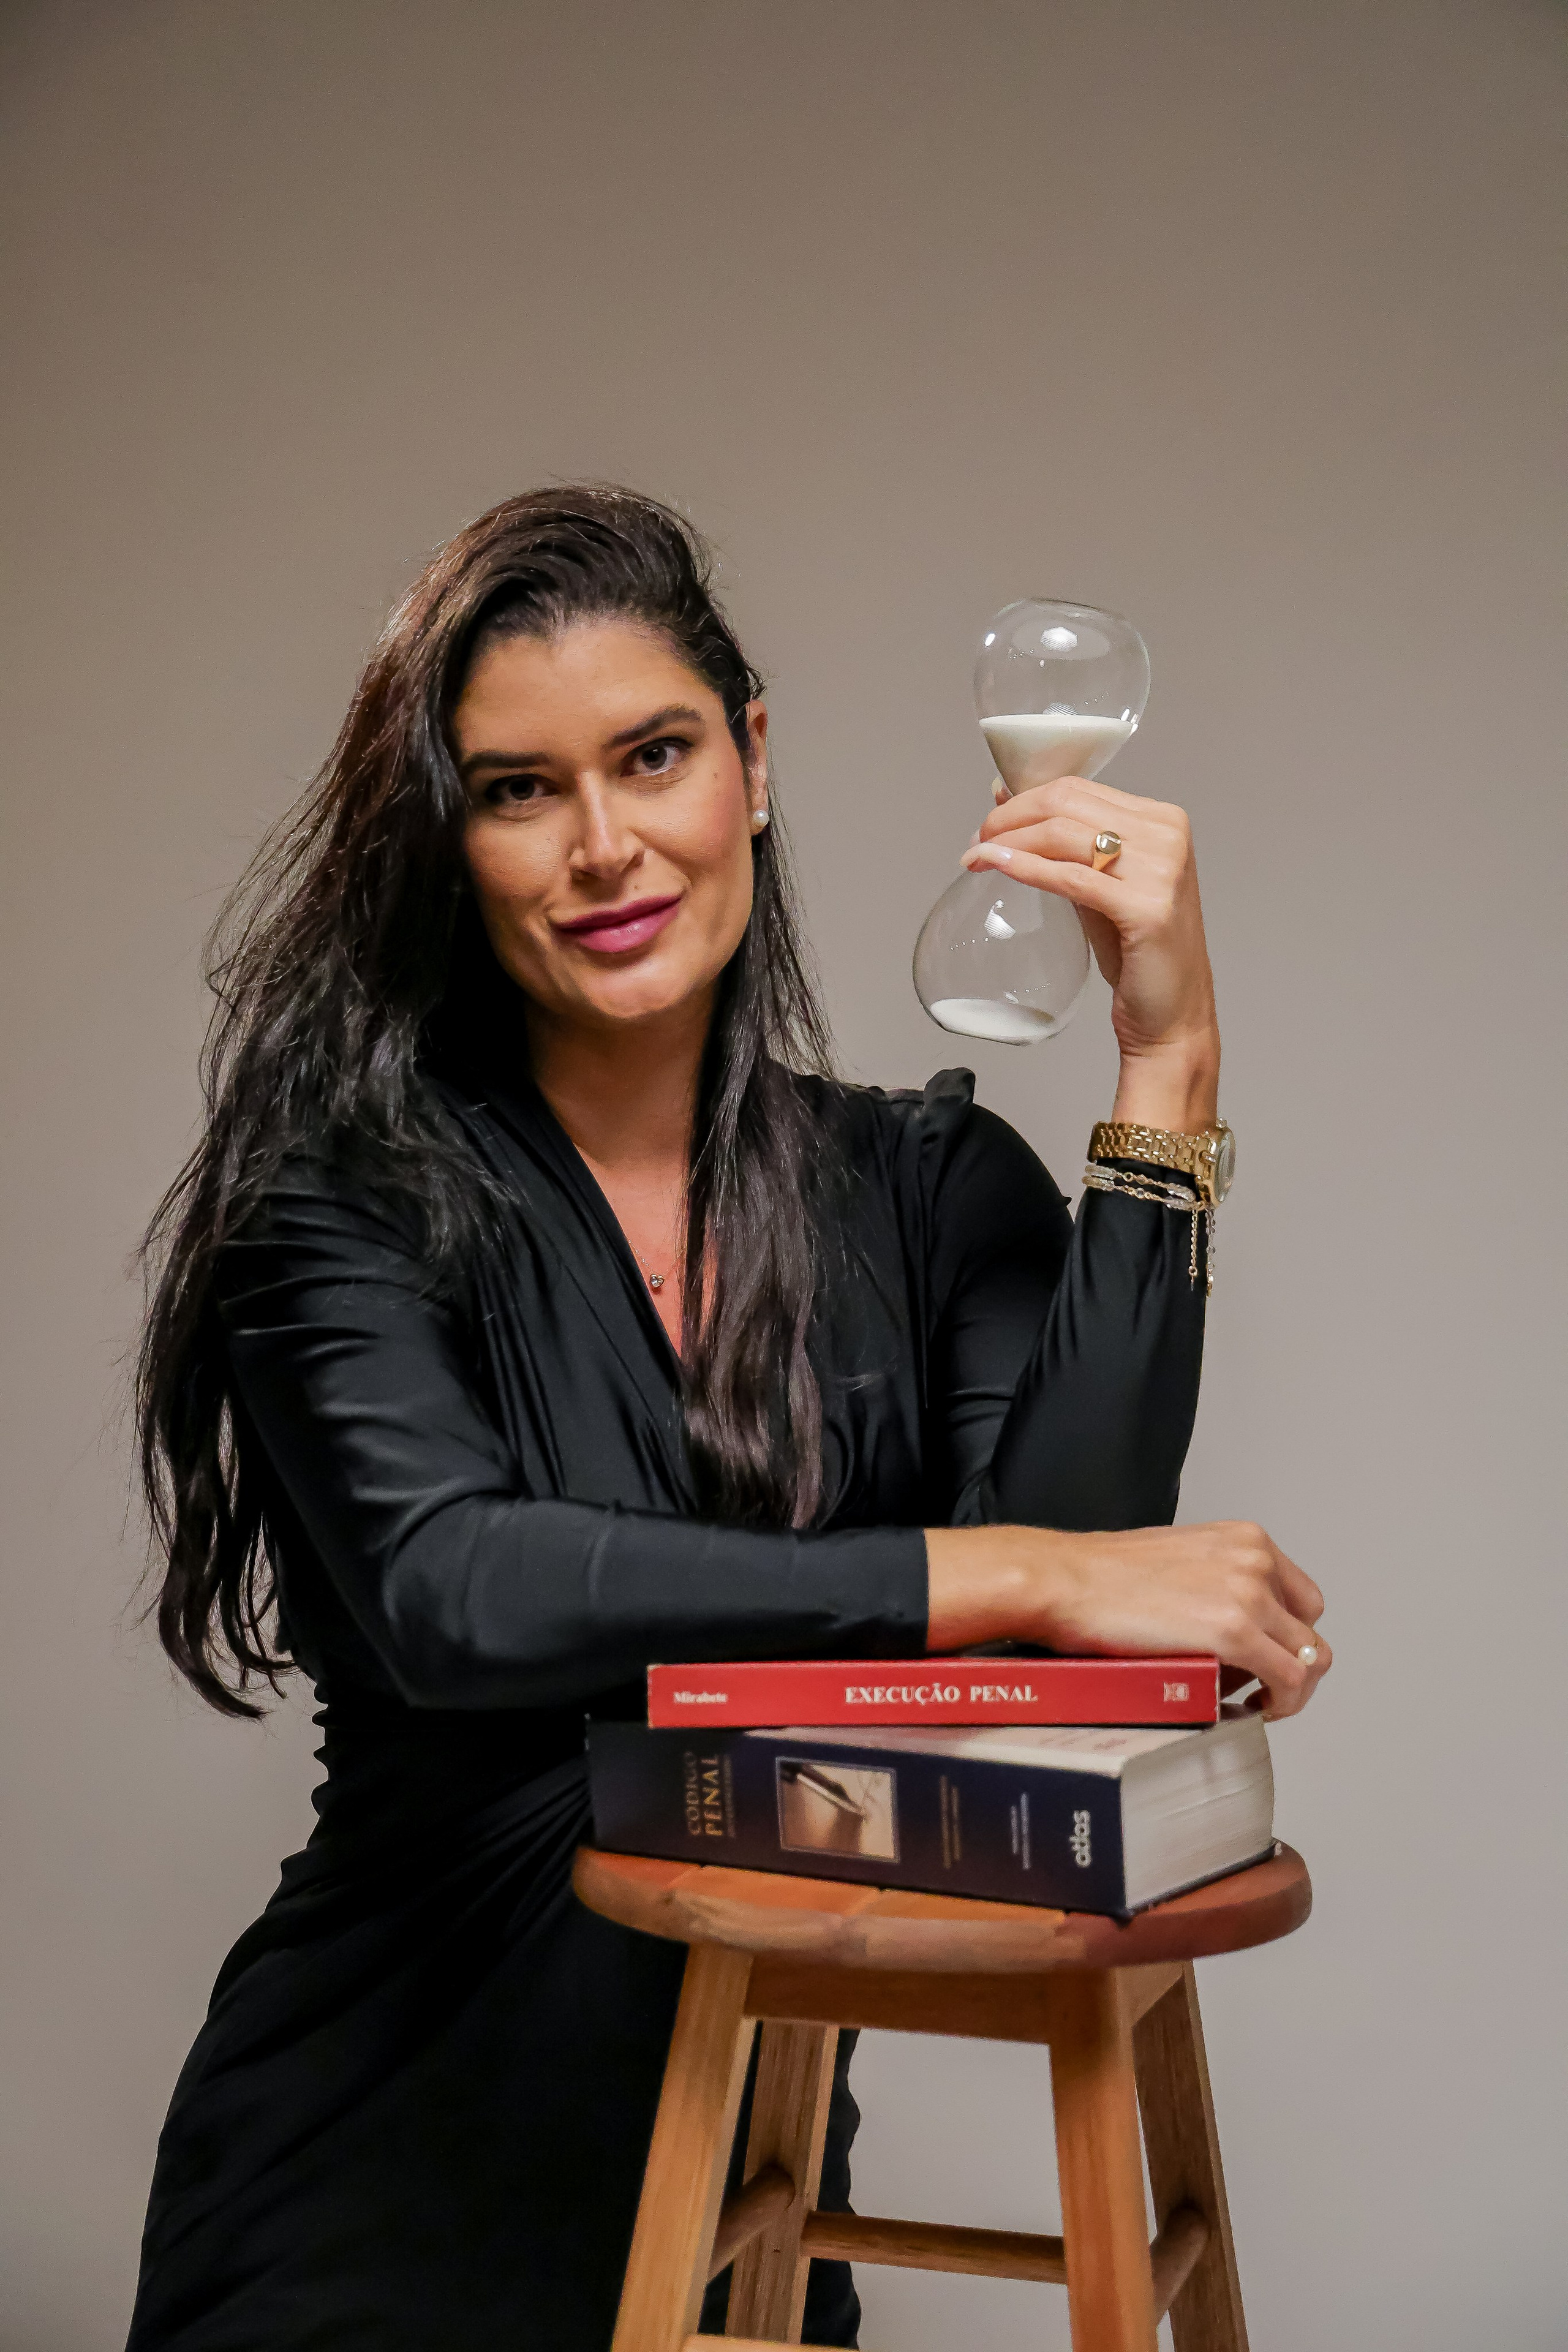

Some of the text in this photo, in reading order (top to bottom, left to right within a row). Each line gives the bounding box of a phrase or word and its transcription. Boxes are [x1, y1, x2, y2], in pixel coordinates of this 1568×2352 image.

[845, 1683, 1039, 1706] EXECUÇÃO PENAL
[701, 1754, 723, 1836] PENAL
